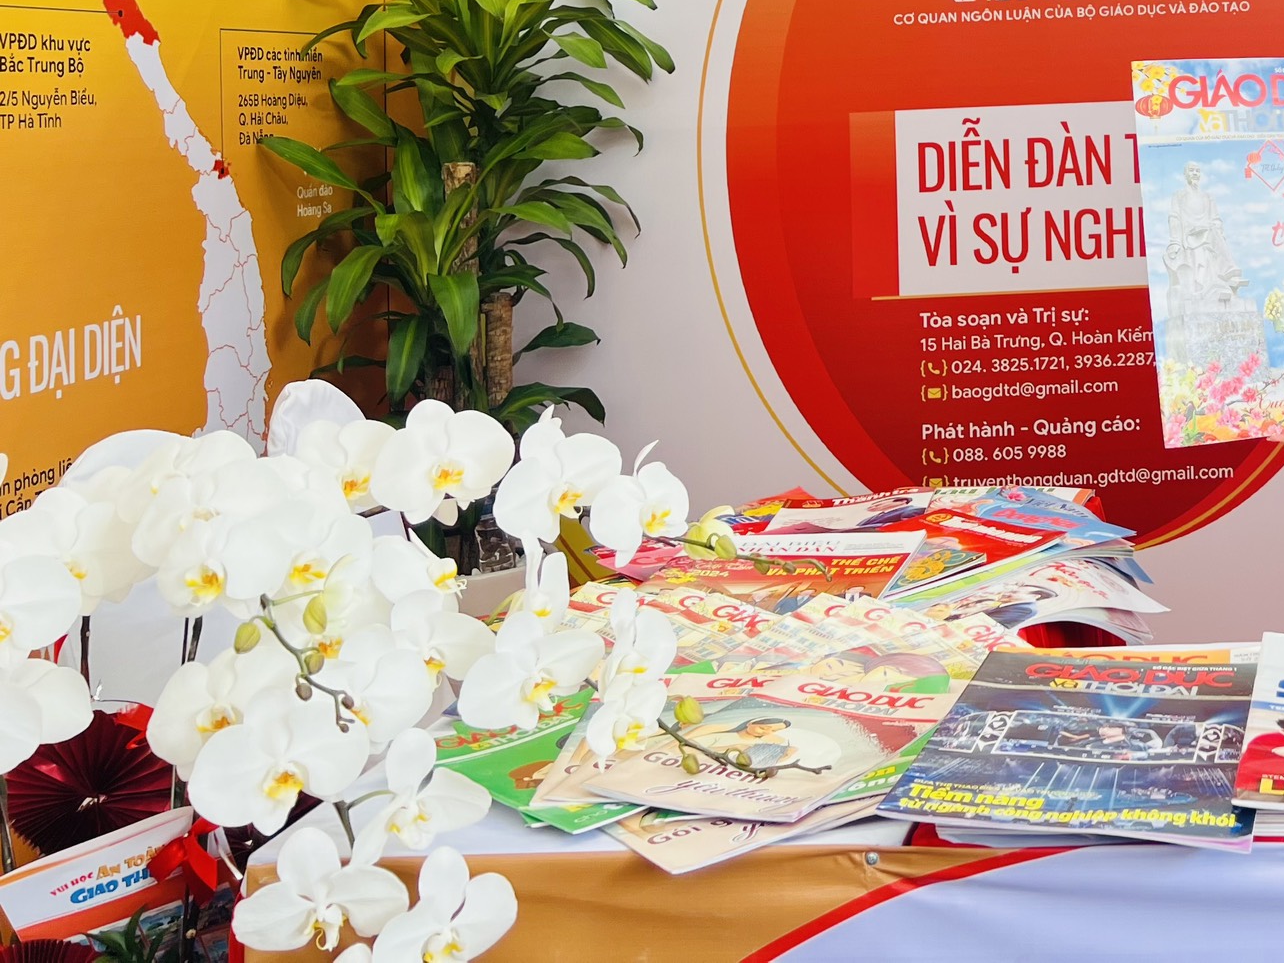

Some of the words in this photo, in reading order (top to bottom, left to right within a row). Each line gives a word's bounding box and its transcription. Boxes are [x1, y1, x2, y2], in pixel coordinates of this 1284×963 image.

[893, 11, 916, 26] CƠ
[917, 11, 957, 24] QUAN
[961, 7, 1002, 23] NGÔN
[1006, 6, 1042, 23] LUẬN
[1044, 4, 1073, 19] CỦA
[1077, 4, 1096, 21] BỘ
[1099, 3, 1134, 17] GIÁO
[1138, 3, 1166, 19] DỤC
[1168, 0, 1187, 14] VÀ
[1189, 0, 1220, 14] ĐÀO
[1222, 0, 1250, 16] TẠO
[0, 53, 25, 74] Bắc
[27, 57, 65, 78] Trung
[68, 57, 85, 78] Bộ
[238, 66, 265, 83] Trung
[273, 66, 287, 83] Tây
[290, 67, 322, 83] Nguyên
[0, 91, 19, 107] 2/5
[22, 88, 68, 109] Nguyễn
[71, 88, 97, 106] Biểu,
[1168, 69, 1267, 109] GIÁO
[918, 117, 1010, 193] DIỄN
[1025, 121, 1111, 188] ĐÀN
[918, 200, 958, 266] VÌ
[973, 207, 1032, 273] SỰ
[920, 312, 952, 328] Tòa
[957, 312, 1001, 330] soạn
[1006, 309, 1028, 325] và
[1033, 307, 1056, 327] Trị
[1061, 308, 1090, 323] sự:
[28, 328, 76, 399] ĐẠI
[84, 304, 142, 385] DIỆN
[952, 359, 986, 374] 024.
[991, 355, 1070, 373] 3825.1721,
[1074, 351, 1156, 368] 3936.2287,
[952, 379, 1118, 402] baogdtd@gmail.com
[922, 421, 963, 440] Phát
[969, 418, 1015, 438] hành
[1033, 417, 1097, 441] Quảng
[1101, 416, 1140, 432] cáo:
[953, 464, 1234, 487] truyenthongduan.gdtd@gmail.com
[1026, 663, 1141, 683] GIÁO
[1143, 670, 1235, 687] DỤC
[798, 682, 873, 702] GIÁO
[873, 694, 935, 709] DỤC
[910, 782, 975, 803] Tiềm
[1119, 808, 1188, 825] không
[1189, 811, 1238, 827] khói
[96, 864, 121, 880] AN
[70, 879, 119, 904] GIAO
